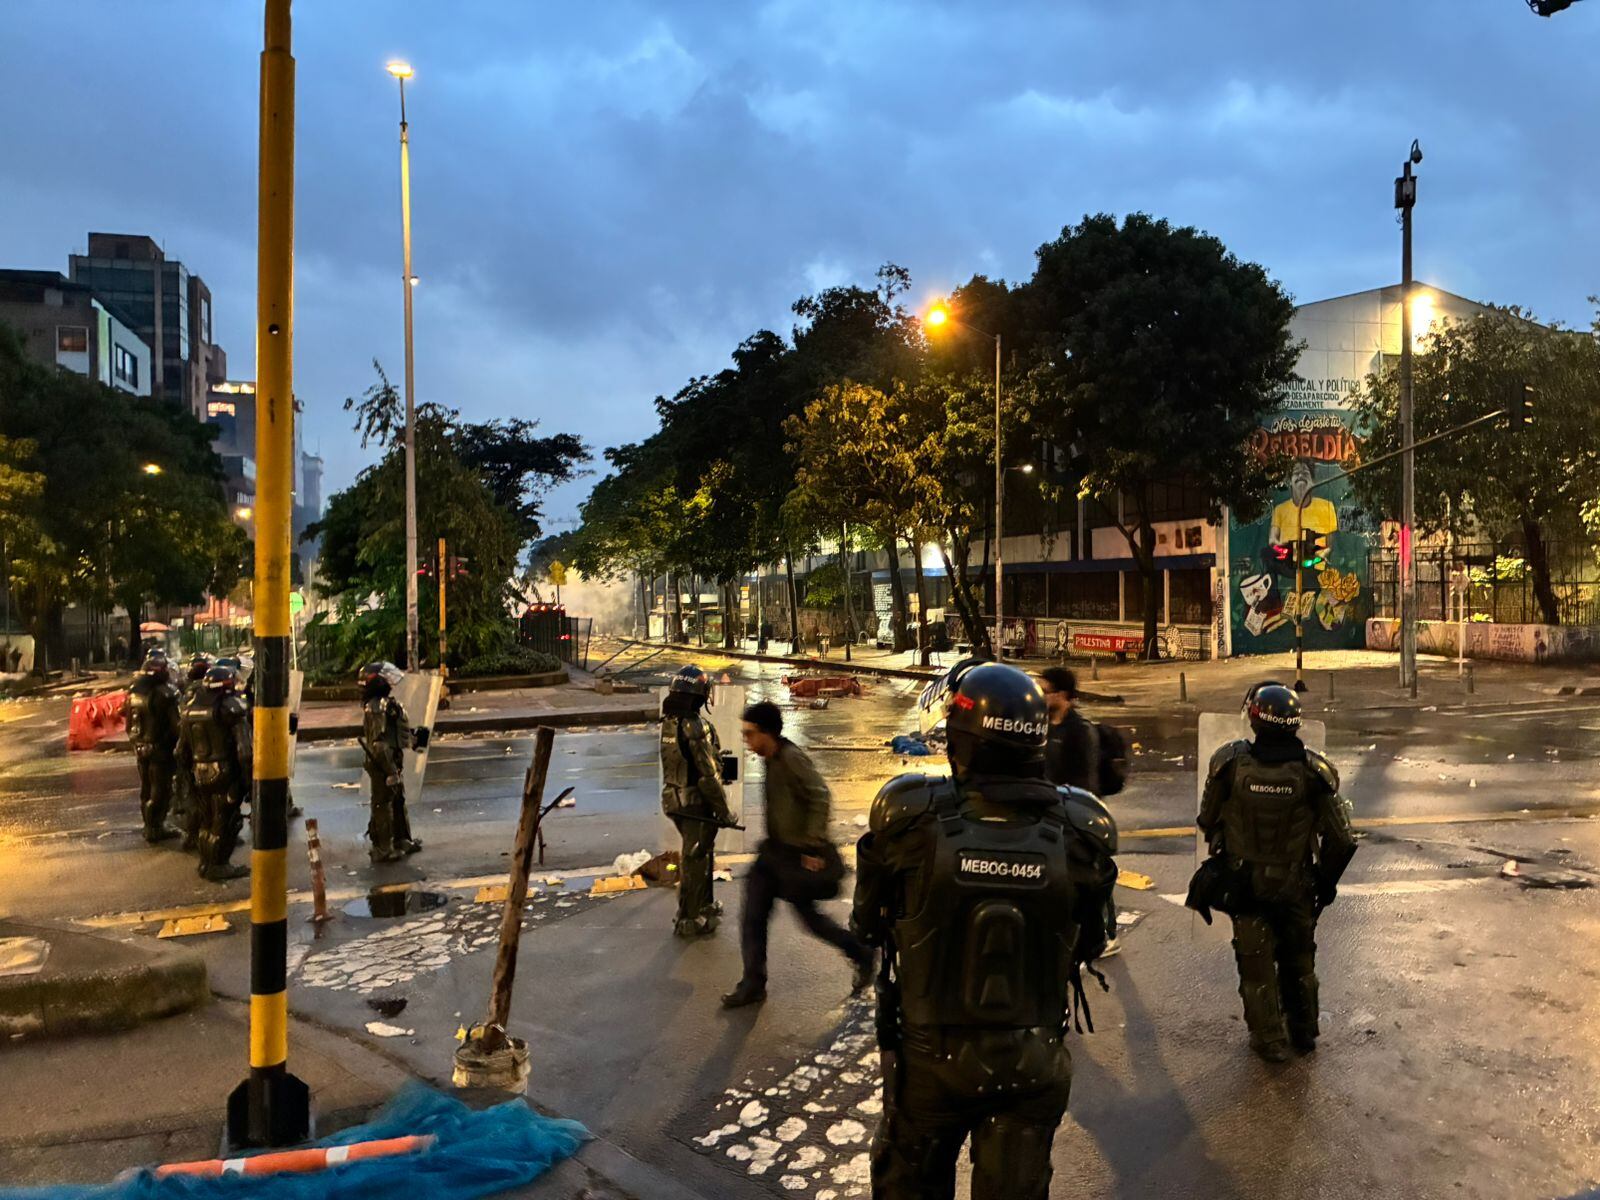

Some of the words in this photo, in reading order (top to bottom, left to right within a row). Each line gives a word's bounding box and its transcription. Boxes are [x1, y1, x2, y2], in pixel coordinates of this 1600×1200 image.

[1319, 380, 1325, 391] Y
[1252, 427, 1361, 466] REBELDÍA
[1075, 637, 1111, 648] PALESTINA
[961, 858, 1041, 879] MEBOG-0454
